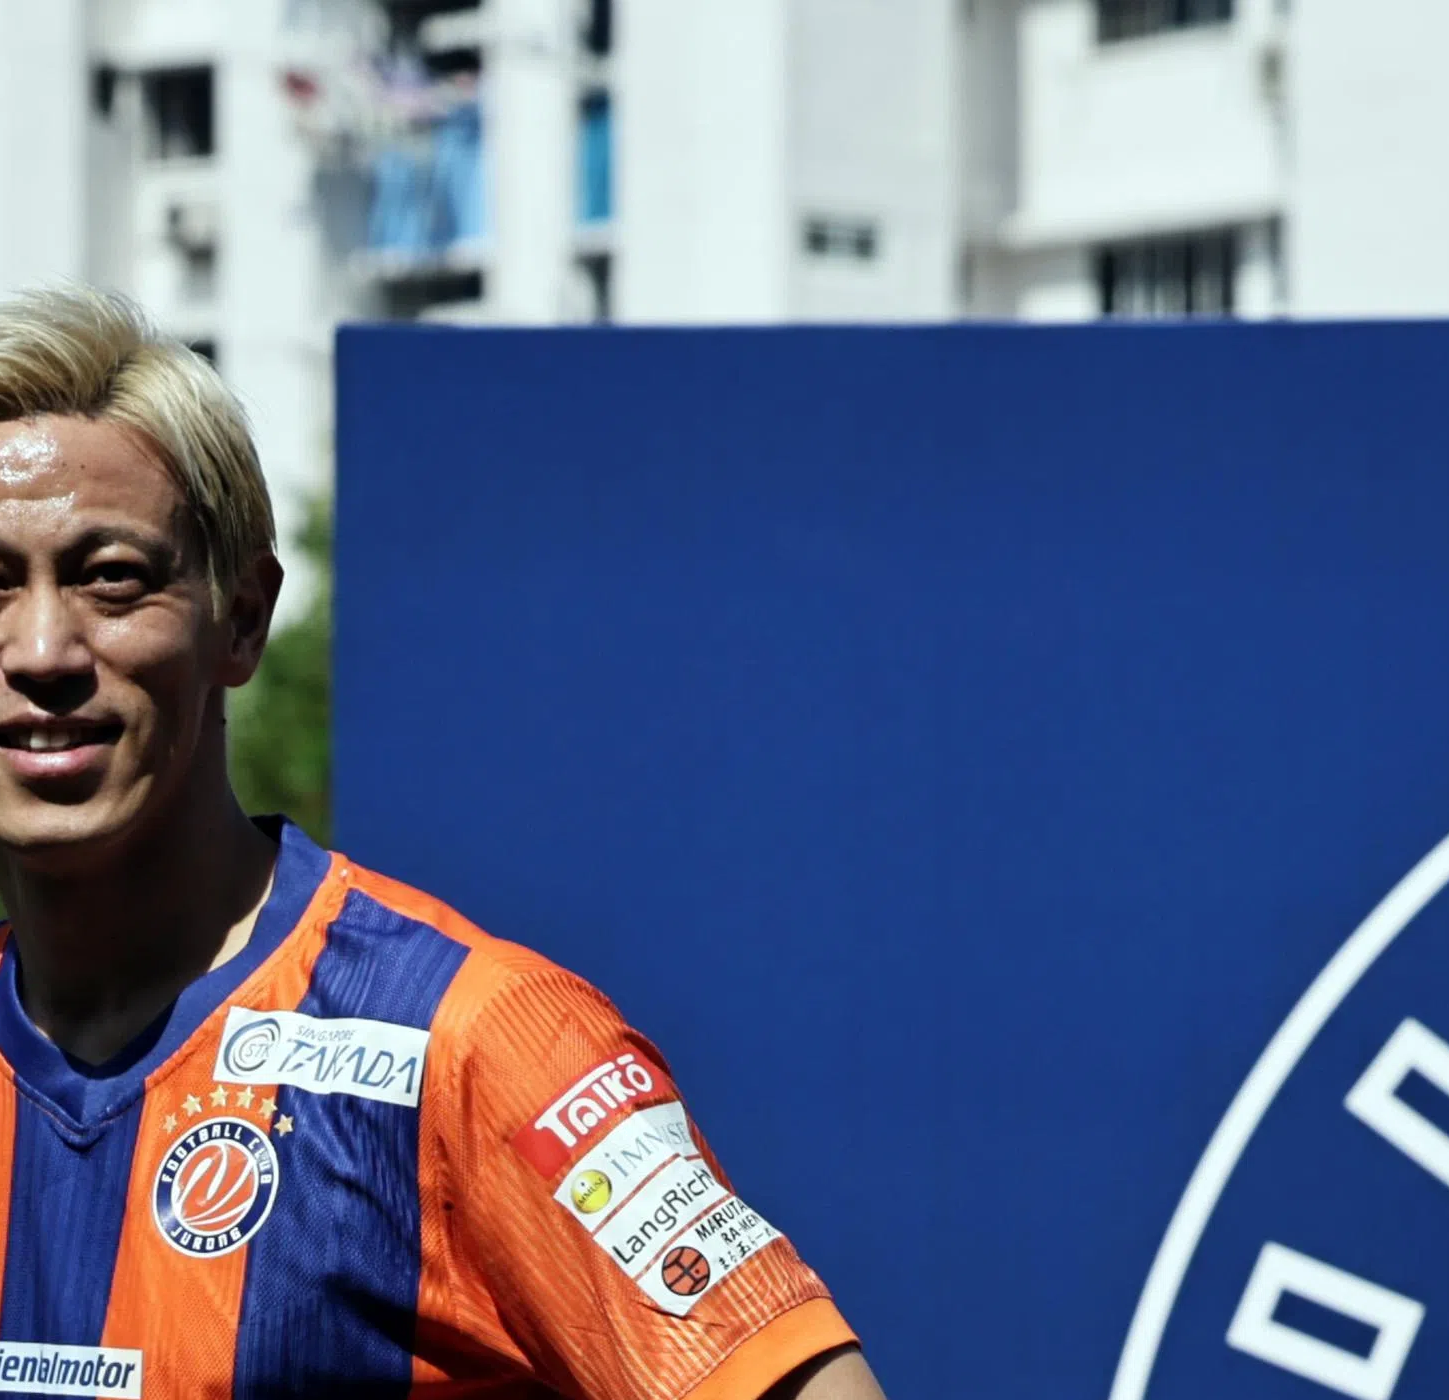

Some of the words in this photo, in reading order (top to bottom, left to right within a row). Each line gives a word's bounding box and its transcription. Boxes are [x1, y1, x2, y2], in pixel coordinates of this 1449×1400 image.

[295, 1025, 355, 1042] SINGAPORE
[278, 1039, 418, 1095] TAKADA
[162, 1123, 243, 1183] FOOTBALL
[249, 1139, 273, 1185] CLUB
[169, 1226, 243, 1251] JURONG
[612, 1167, 716, 1265] LangRich
